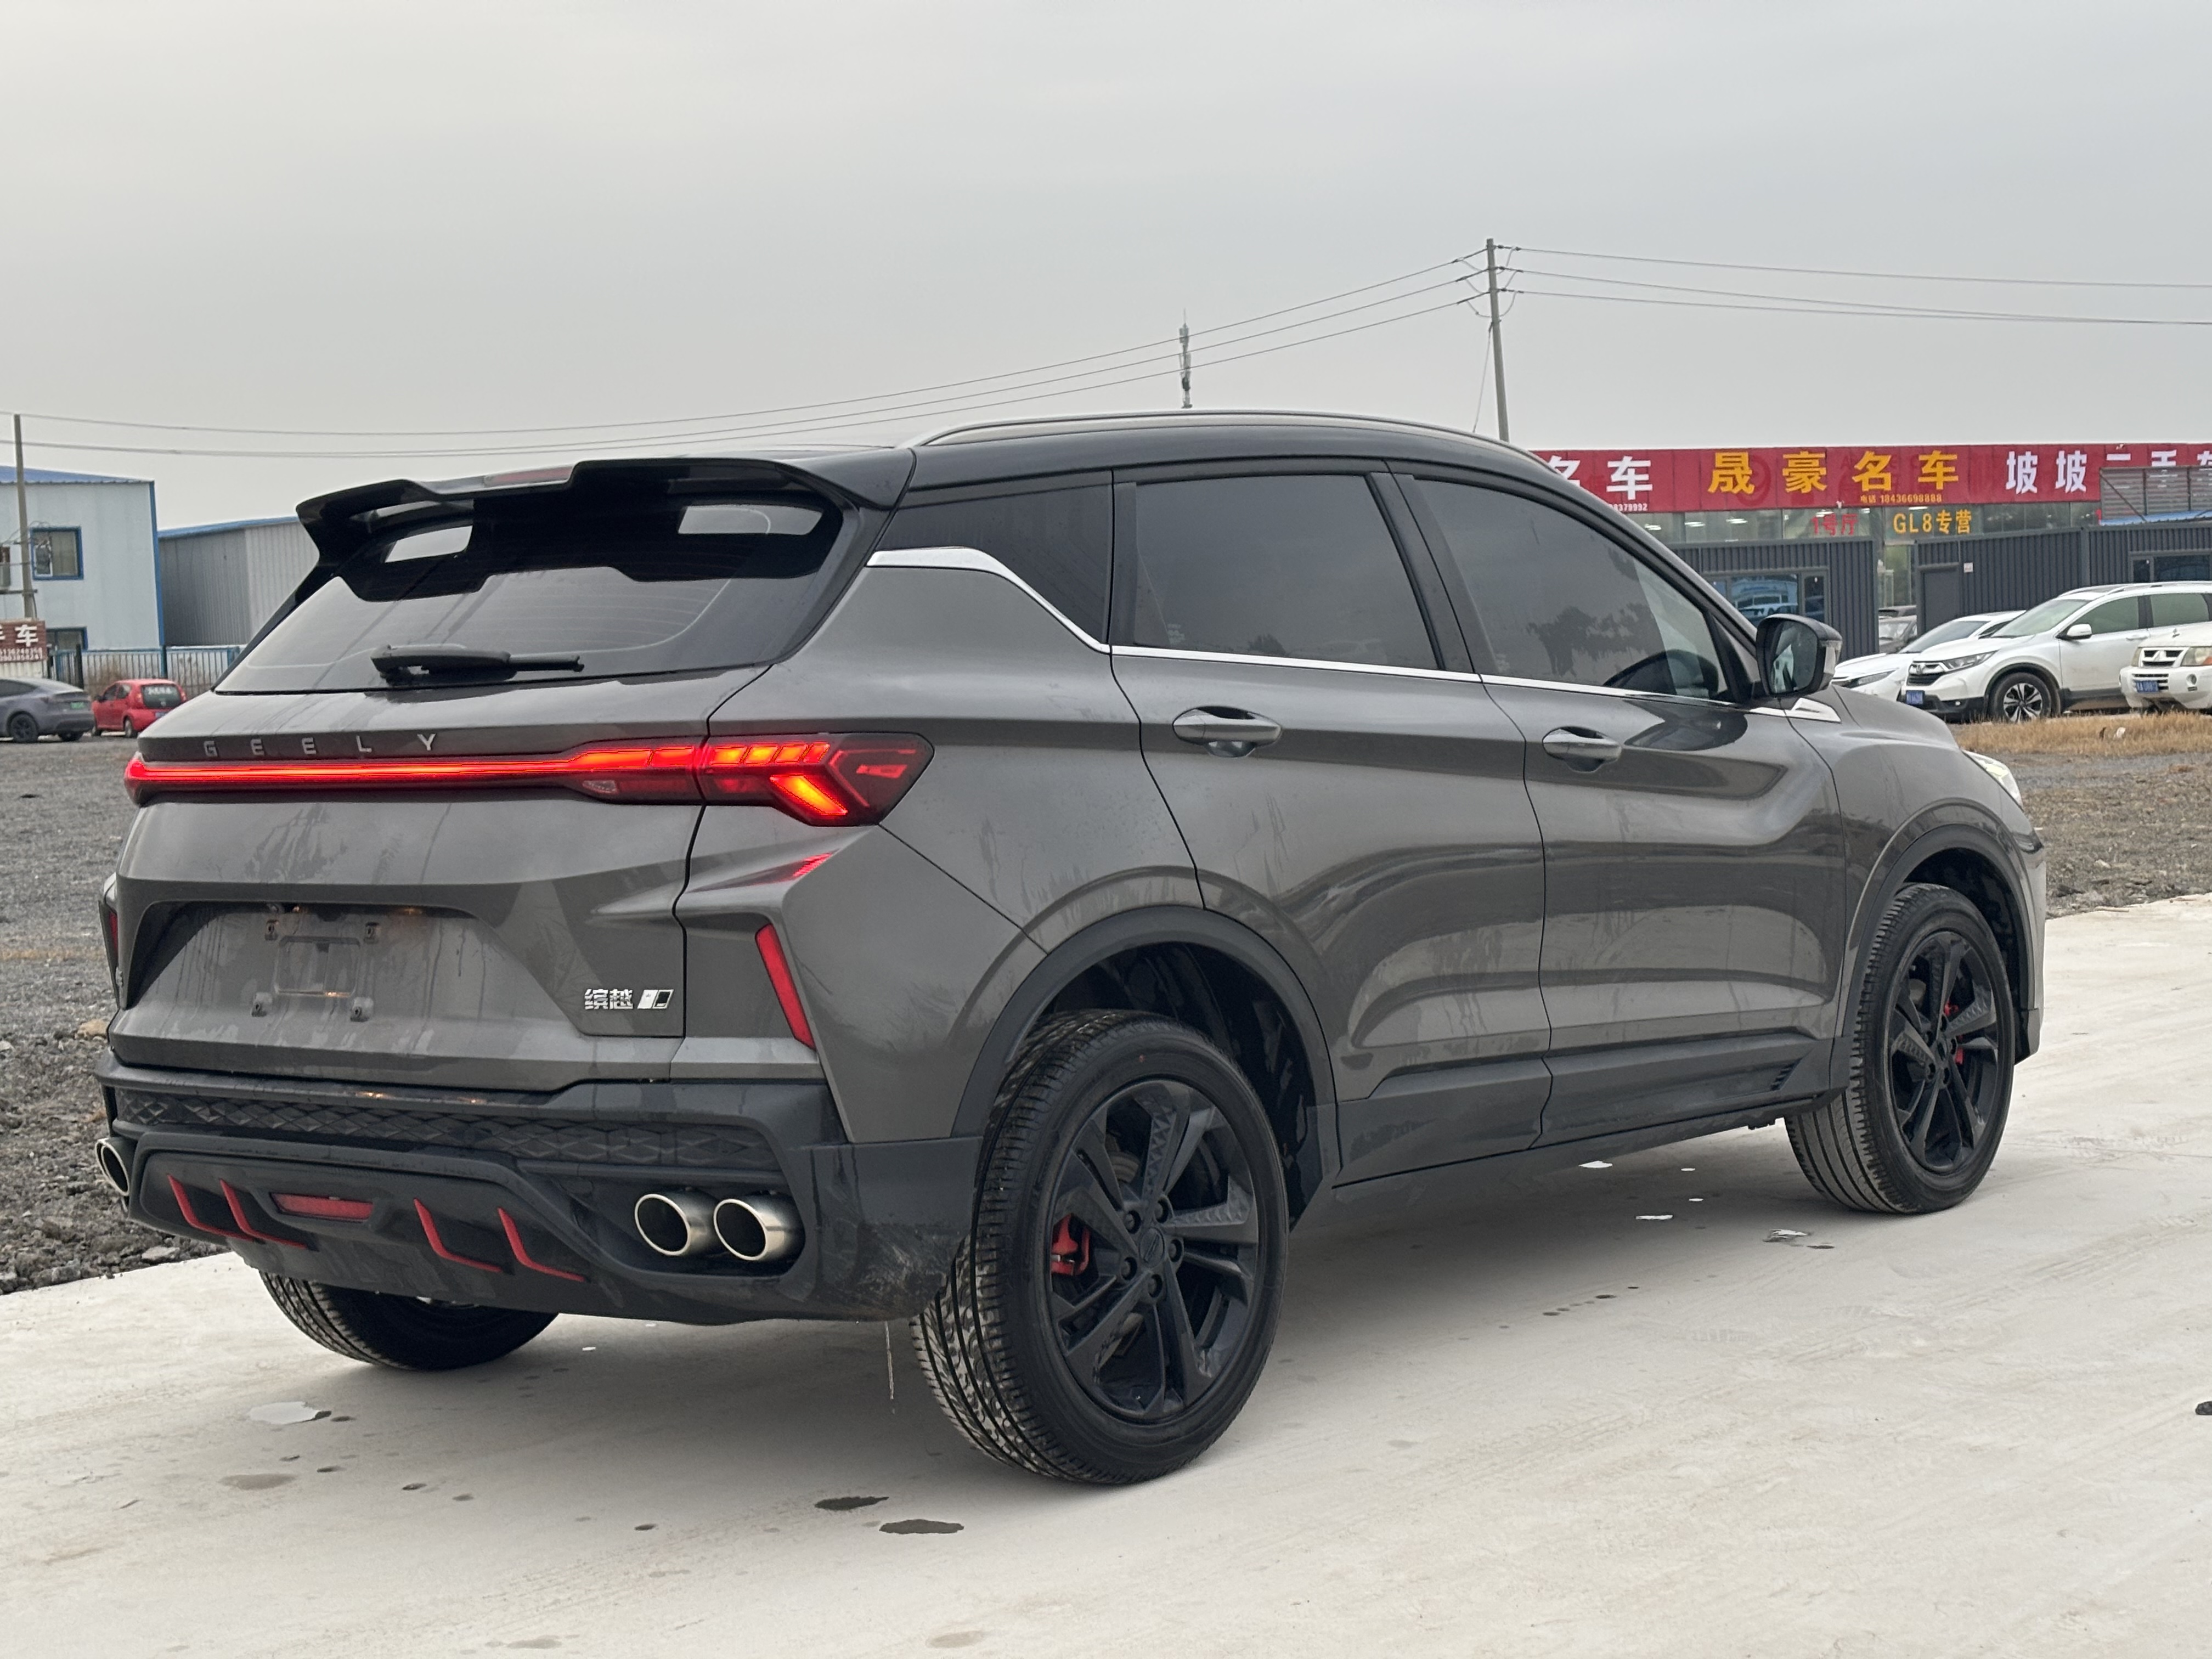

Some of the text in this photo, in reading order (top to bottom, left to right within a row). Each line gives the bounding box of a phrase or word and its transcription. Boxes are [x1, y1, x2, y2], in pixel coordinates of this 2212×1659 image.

[1708, 450, 1958, 494] 晟豪名车
[1894, 509, 1972, 534] GL8专营
[204, 733, 436, 757] GEELY
[584, 989, 634, 1010] 缤越
